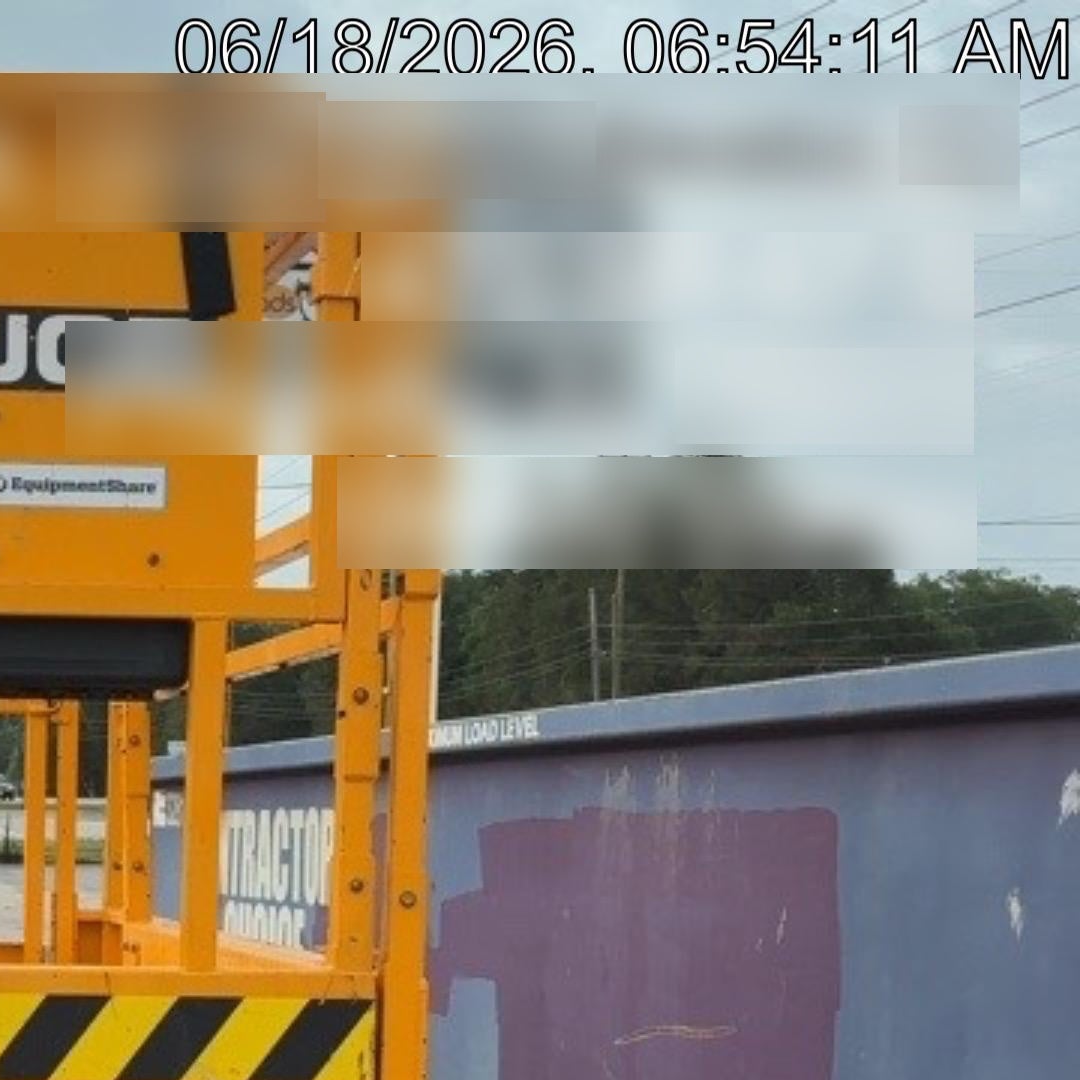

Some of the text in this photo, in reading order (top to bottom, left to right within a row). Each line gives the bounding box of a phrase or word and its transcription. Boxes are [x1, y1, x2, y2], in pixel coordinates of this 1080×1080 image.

[11, 476, 157, 496] EquipmentShare
[464, 718, 499, 745] LOAD
[501, 713, 539, 742] LEVEL
